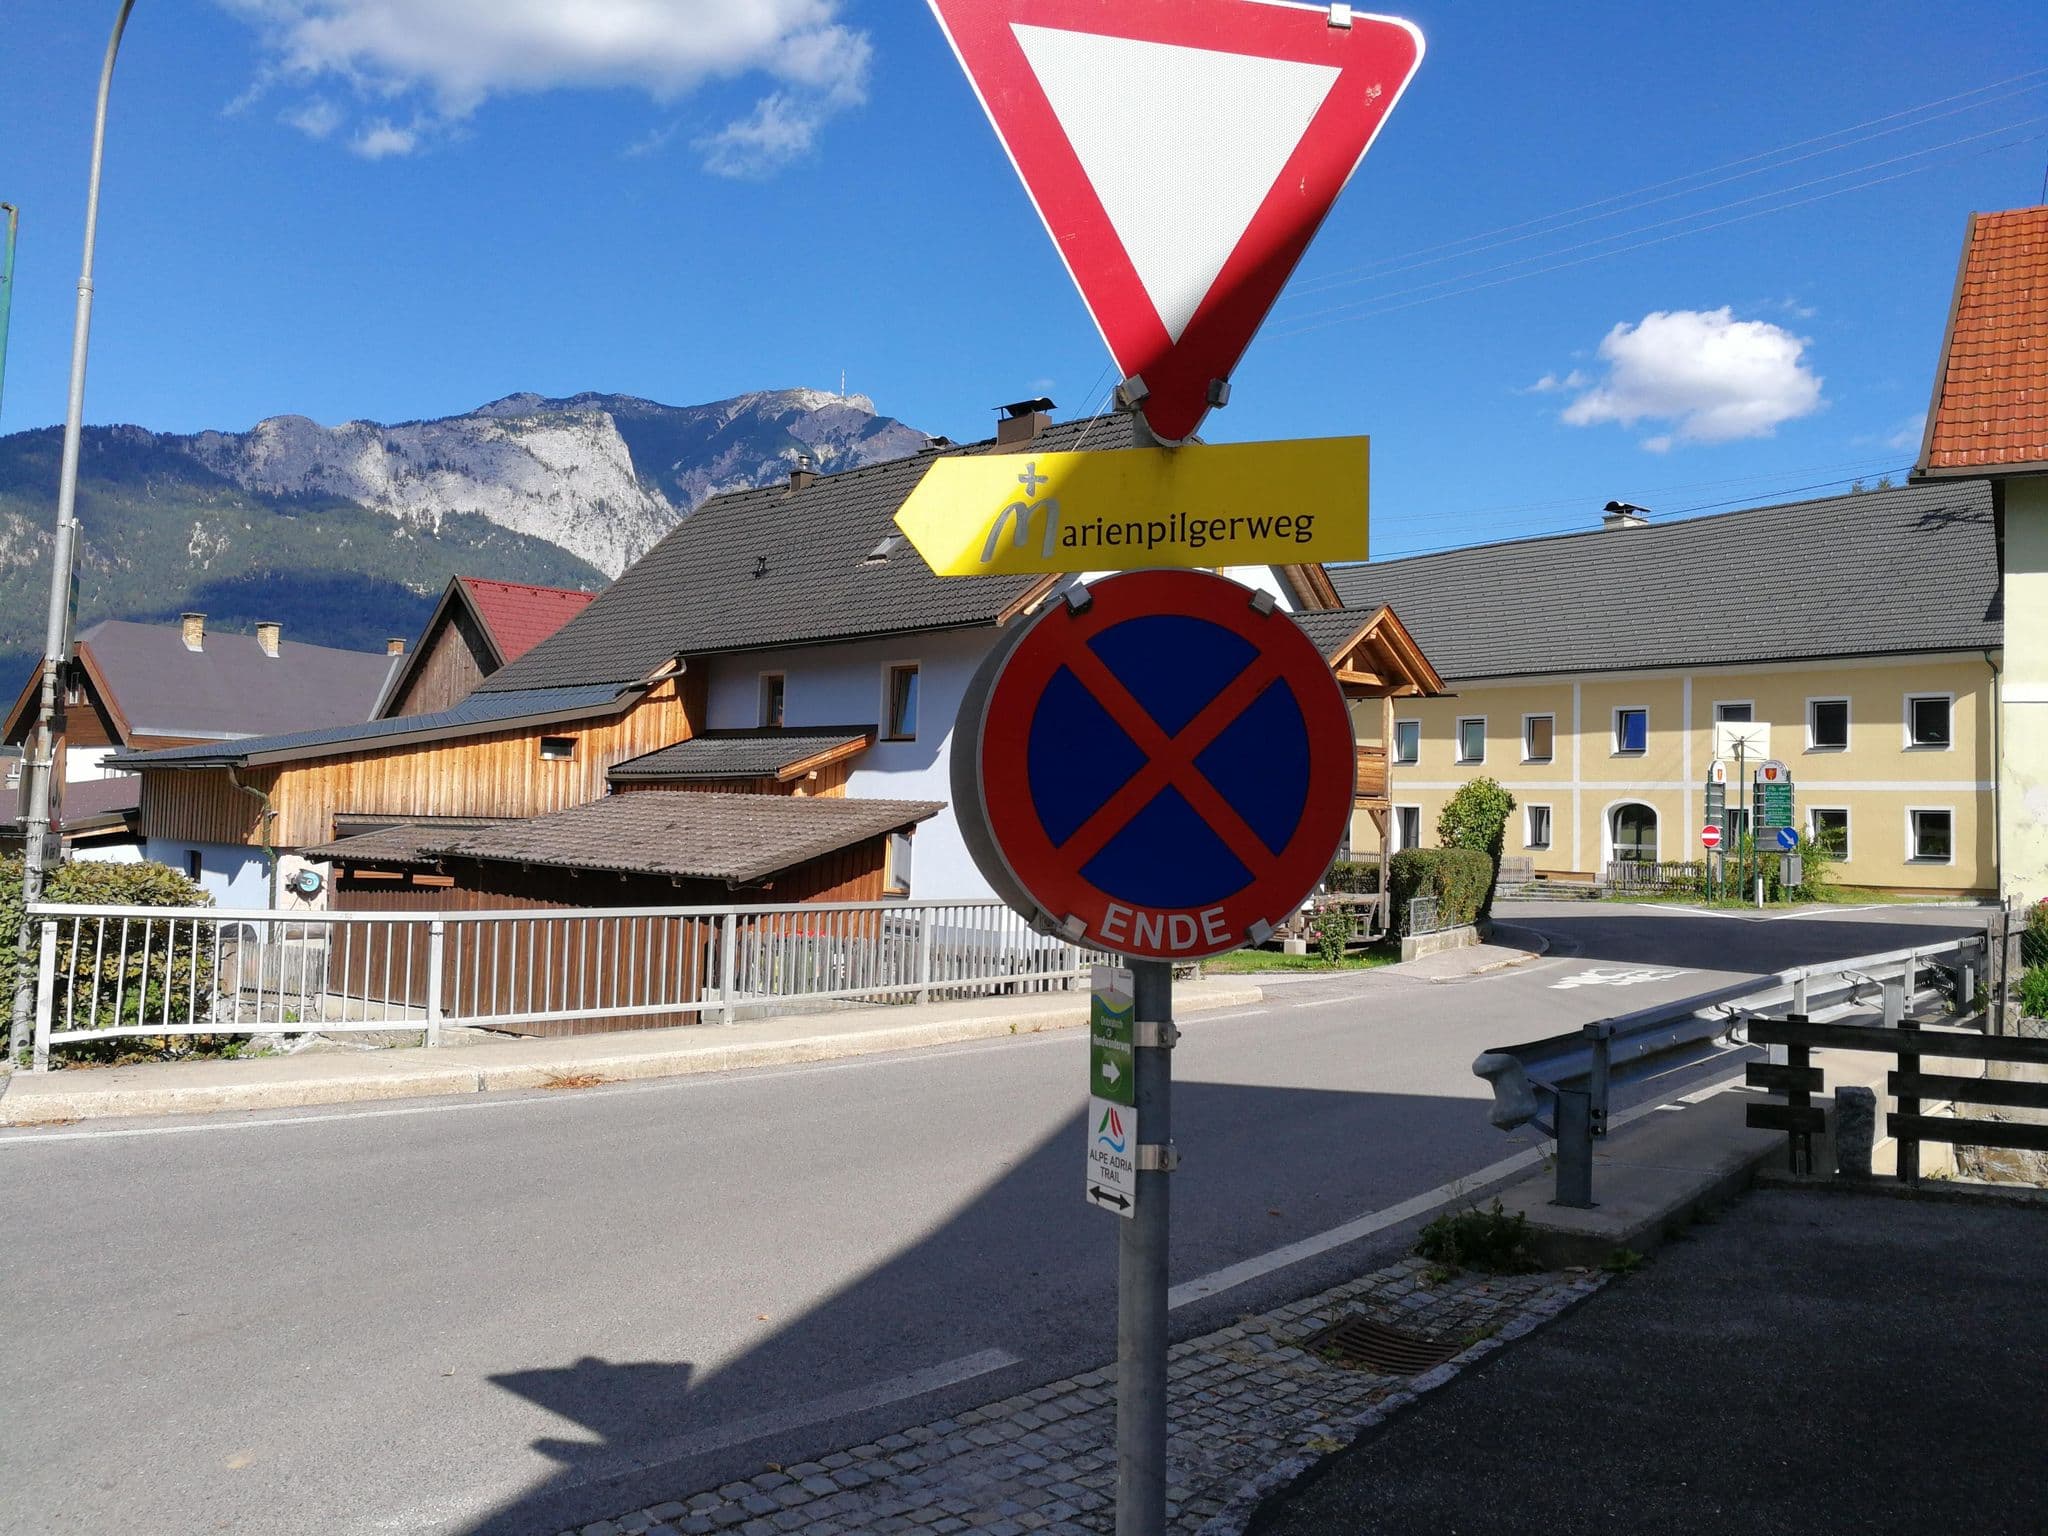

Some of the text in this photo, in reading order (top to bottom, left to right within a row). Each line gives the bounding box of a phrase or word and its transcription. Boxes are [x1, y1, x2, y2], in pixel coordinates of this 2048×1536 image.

[1100, 902, 1232, 950] ENDE
[1089, 1149, 1133, 1173] ALPE ADRIA
[1100, 1166, 1121, 1184] TRAIL
